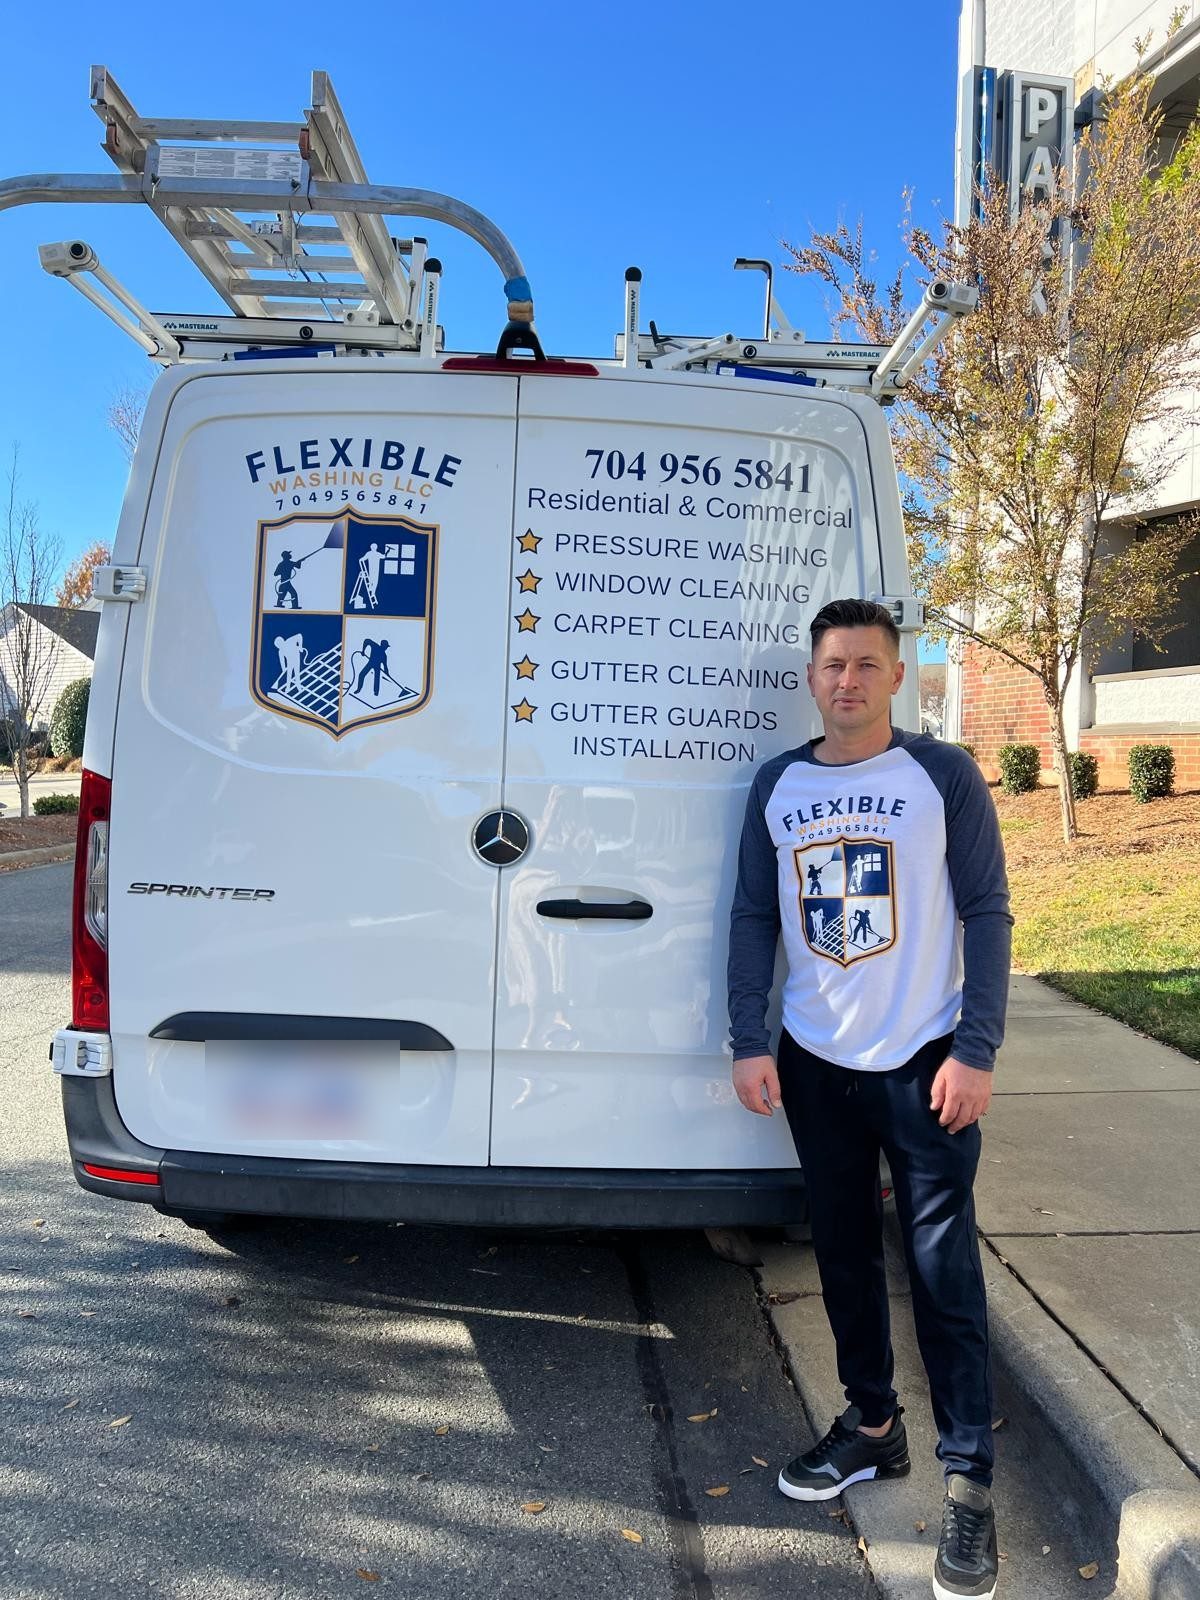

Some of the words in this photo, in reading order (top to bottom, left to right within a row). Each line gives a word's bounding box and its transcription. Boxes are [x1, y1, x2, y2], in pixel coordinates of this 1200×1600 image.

[245, 437, 462, 488] FLEXIBLE
[585, 448, 647, 481] 704
[659, 452, 722, 487] 956
[733, 458, 812, 495] 5841
[269, 470, 385, 496] WASHING
[394, 475, 434, 498] LLC
[276, 490, 426, 514] 7049565841
[528, 487, 669, 515] Residential
[678, 495, 697, 516] &
[706, 496, 852, 529] Commercial
[555, 533, 699, 559] PRESSURE
[708, 541, 828, 568] WASHING
[555, 572, 672, 596] WINDOW
[680, 577, 810, 604] CLEANING
[554, 613, 661, 636] CARPET
[668, 618, 800, 645] CLEANING
[551, 660, 658, 684] GUTTER
[668, 665, 799, 691] CLEANING
[550, 702, 657, 726] GUTTER
[667, 706, 778, 731] GUARDS
[573, 736, 755, 763] INSTALLATION
[782, 795, 906, 832] FLEXIBLE
[796, 815, 861, 836] WASHING
[866, 815, 890, 825] LLC
[801, 824, 886, 843] 7049565841
[127, 882, 276, 902] SPRINTER
